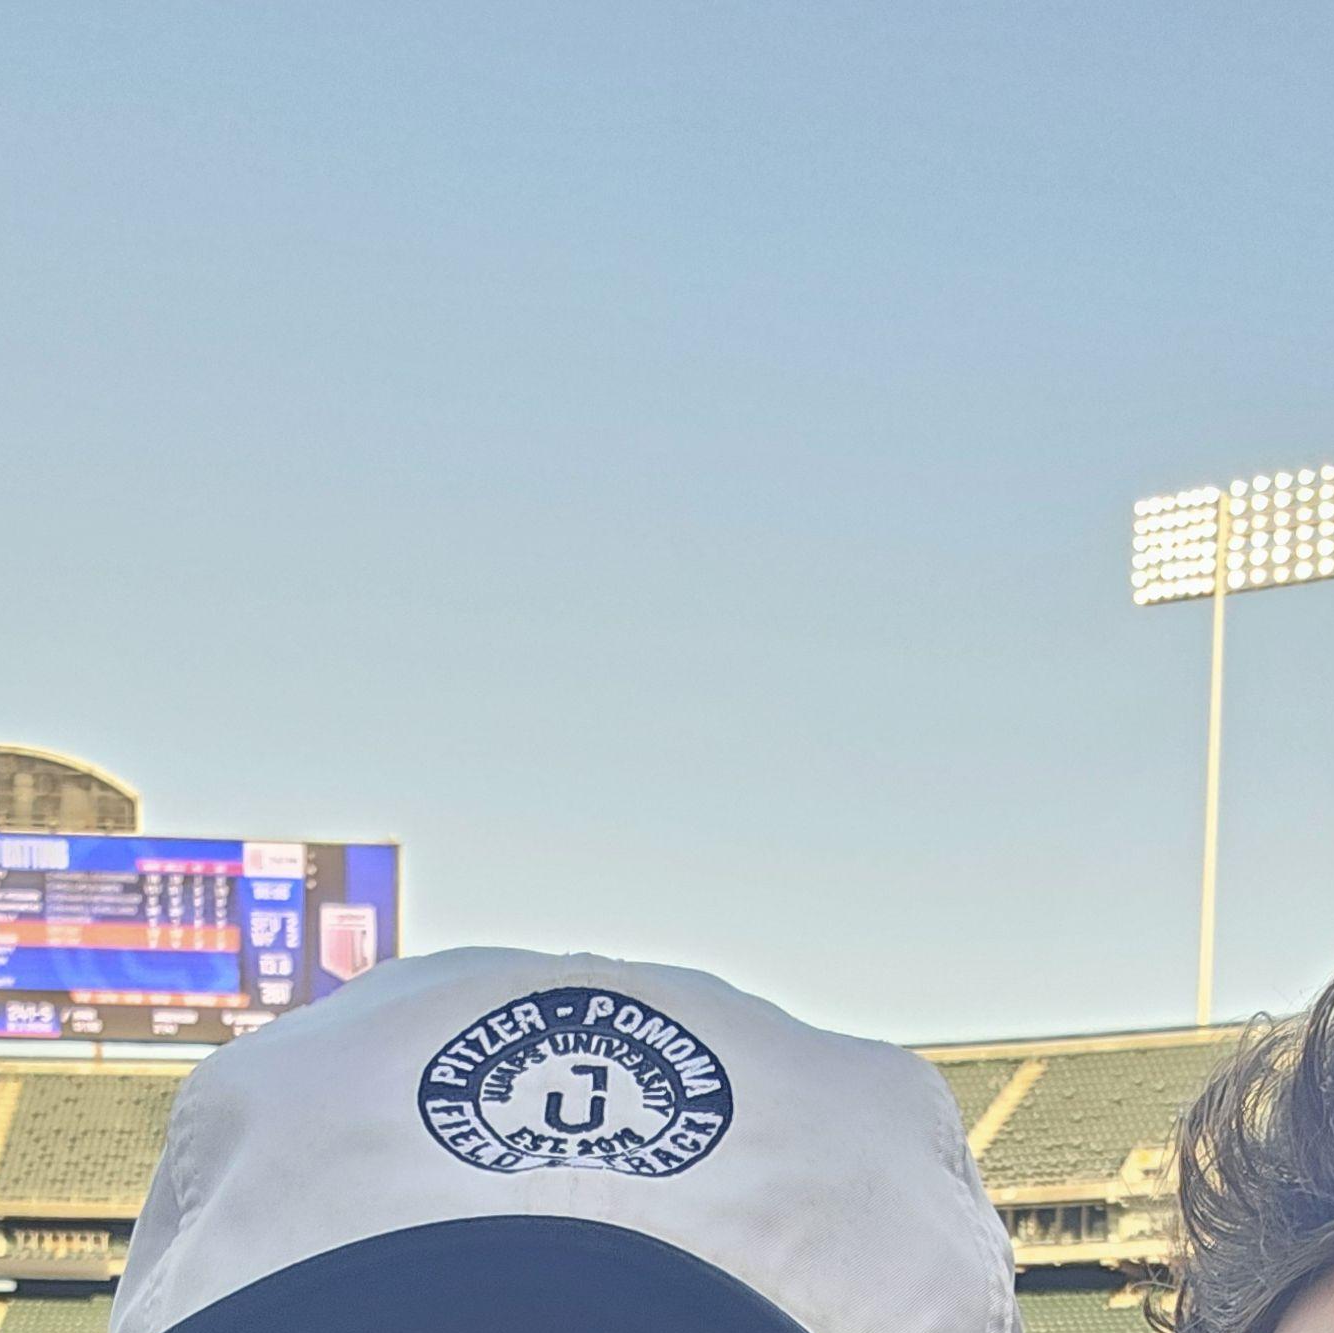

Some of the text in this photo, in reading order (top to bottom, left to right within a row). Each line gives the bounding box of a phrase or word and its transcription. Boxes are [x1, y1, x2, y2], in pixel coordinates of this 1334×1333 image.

[430, 1001, 547, 1087] PITZER
[582, 995, 722, 1099] POMONA
[430, 1104, 524, 1169] FIELD
